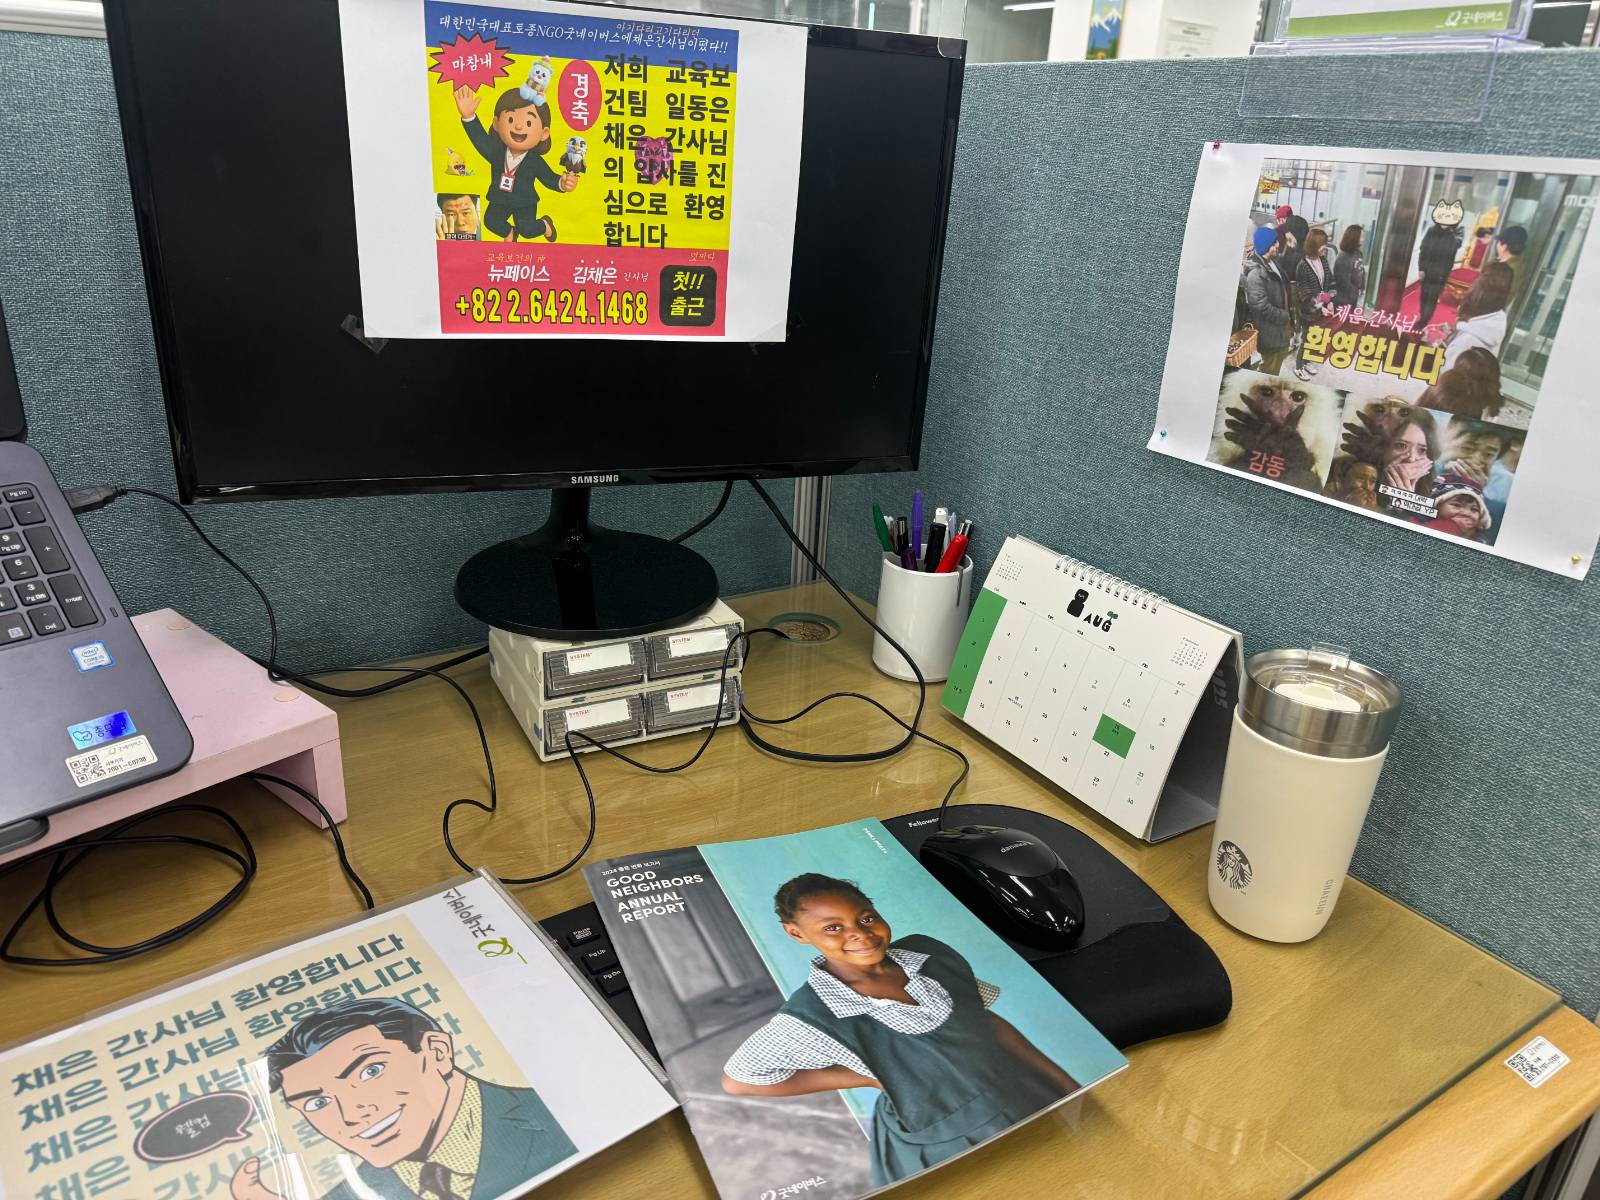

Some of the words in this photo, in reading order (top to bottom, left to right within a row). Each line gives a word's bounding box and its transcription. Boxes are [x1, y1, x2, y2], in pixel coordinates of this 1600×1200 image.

[452, 52, 492, 73] 마참내
[604, 54, 648, 83] 저희
[666, 60, 731, 88] 교육보
[570, 72, 590, 126] 경축
[604, 88, 647, 117] 건팀
[666, 92, 730, 123] 일동은
[603, 122, 649, 151] 채은
[664, 126, 728, 156] 간사님
[603, 156, 624, 184] 의
[706, 162, 727, 189] 진
[603, 188, 669, 217] 심으로
[684, 192, 726, 221] 환영
[603, 221, 668, 249] 합니다
[487, 263, 550, 284] 뉴페이스
[573, 266, 618, 285] 김채은
[672, 270, 705, 292] 첫!!
[670, 296, 705, 317] 출근
[1301, 324, 1447, 386] 환영합니다
[1249, 450, 1286, 478] 감동
[571, 474, 620, 484] SAMSUNG
[1083, 612, 1113, 633] AUG
[601, 868, 618, 876] 2024
[606, 870, 656, 887] GOOD
[610, 874, 704, 898] NEIGHBORS
[618, 891, 683, 912] ANNUAL
[621, 902, 685, 923] REPORT
[11, 1049, 97, 1096] 채은
[107, 1000, 227, 1059] 간사님
[231, 933, 405, 1012] 환영합니다
[18, 1078, 108, 1131] 채은
[116, 1027, 241, 1091] 간사님
[175, 1114, 212, 1139] 웰컴
[25, 1115, 118, 1173] 채은
[778, 1175, 827, 1200] 굿네이버스
